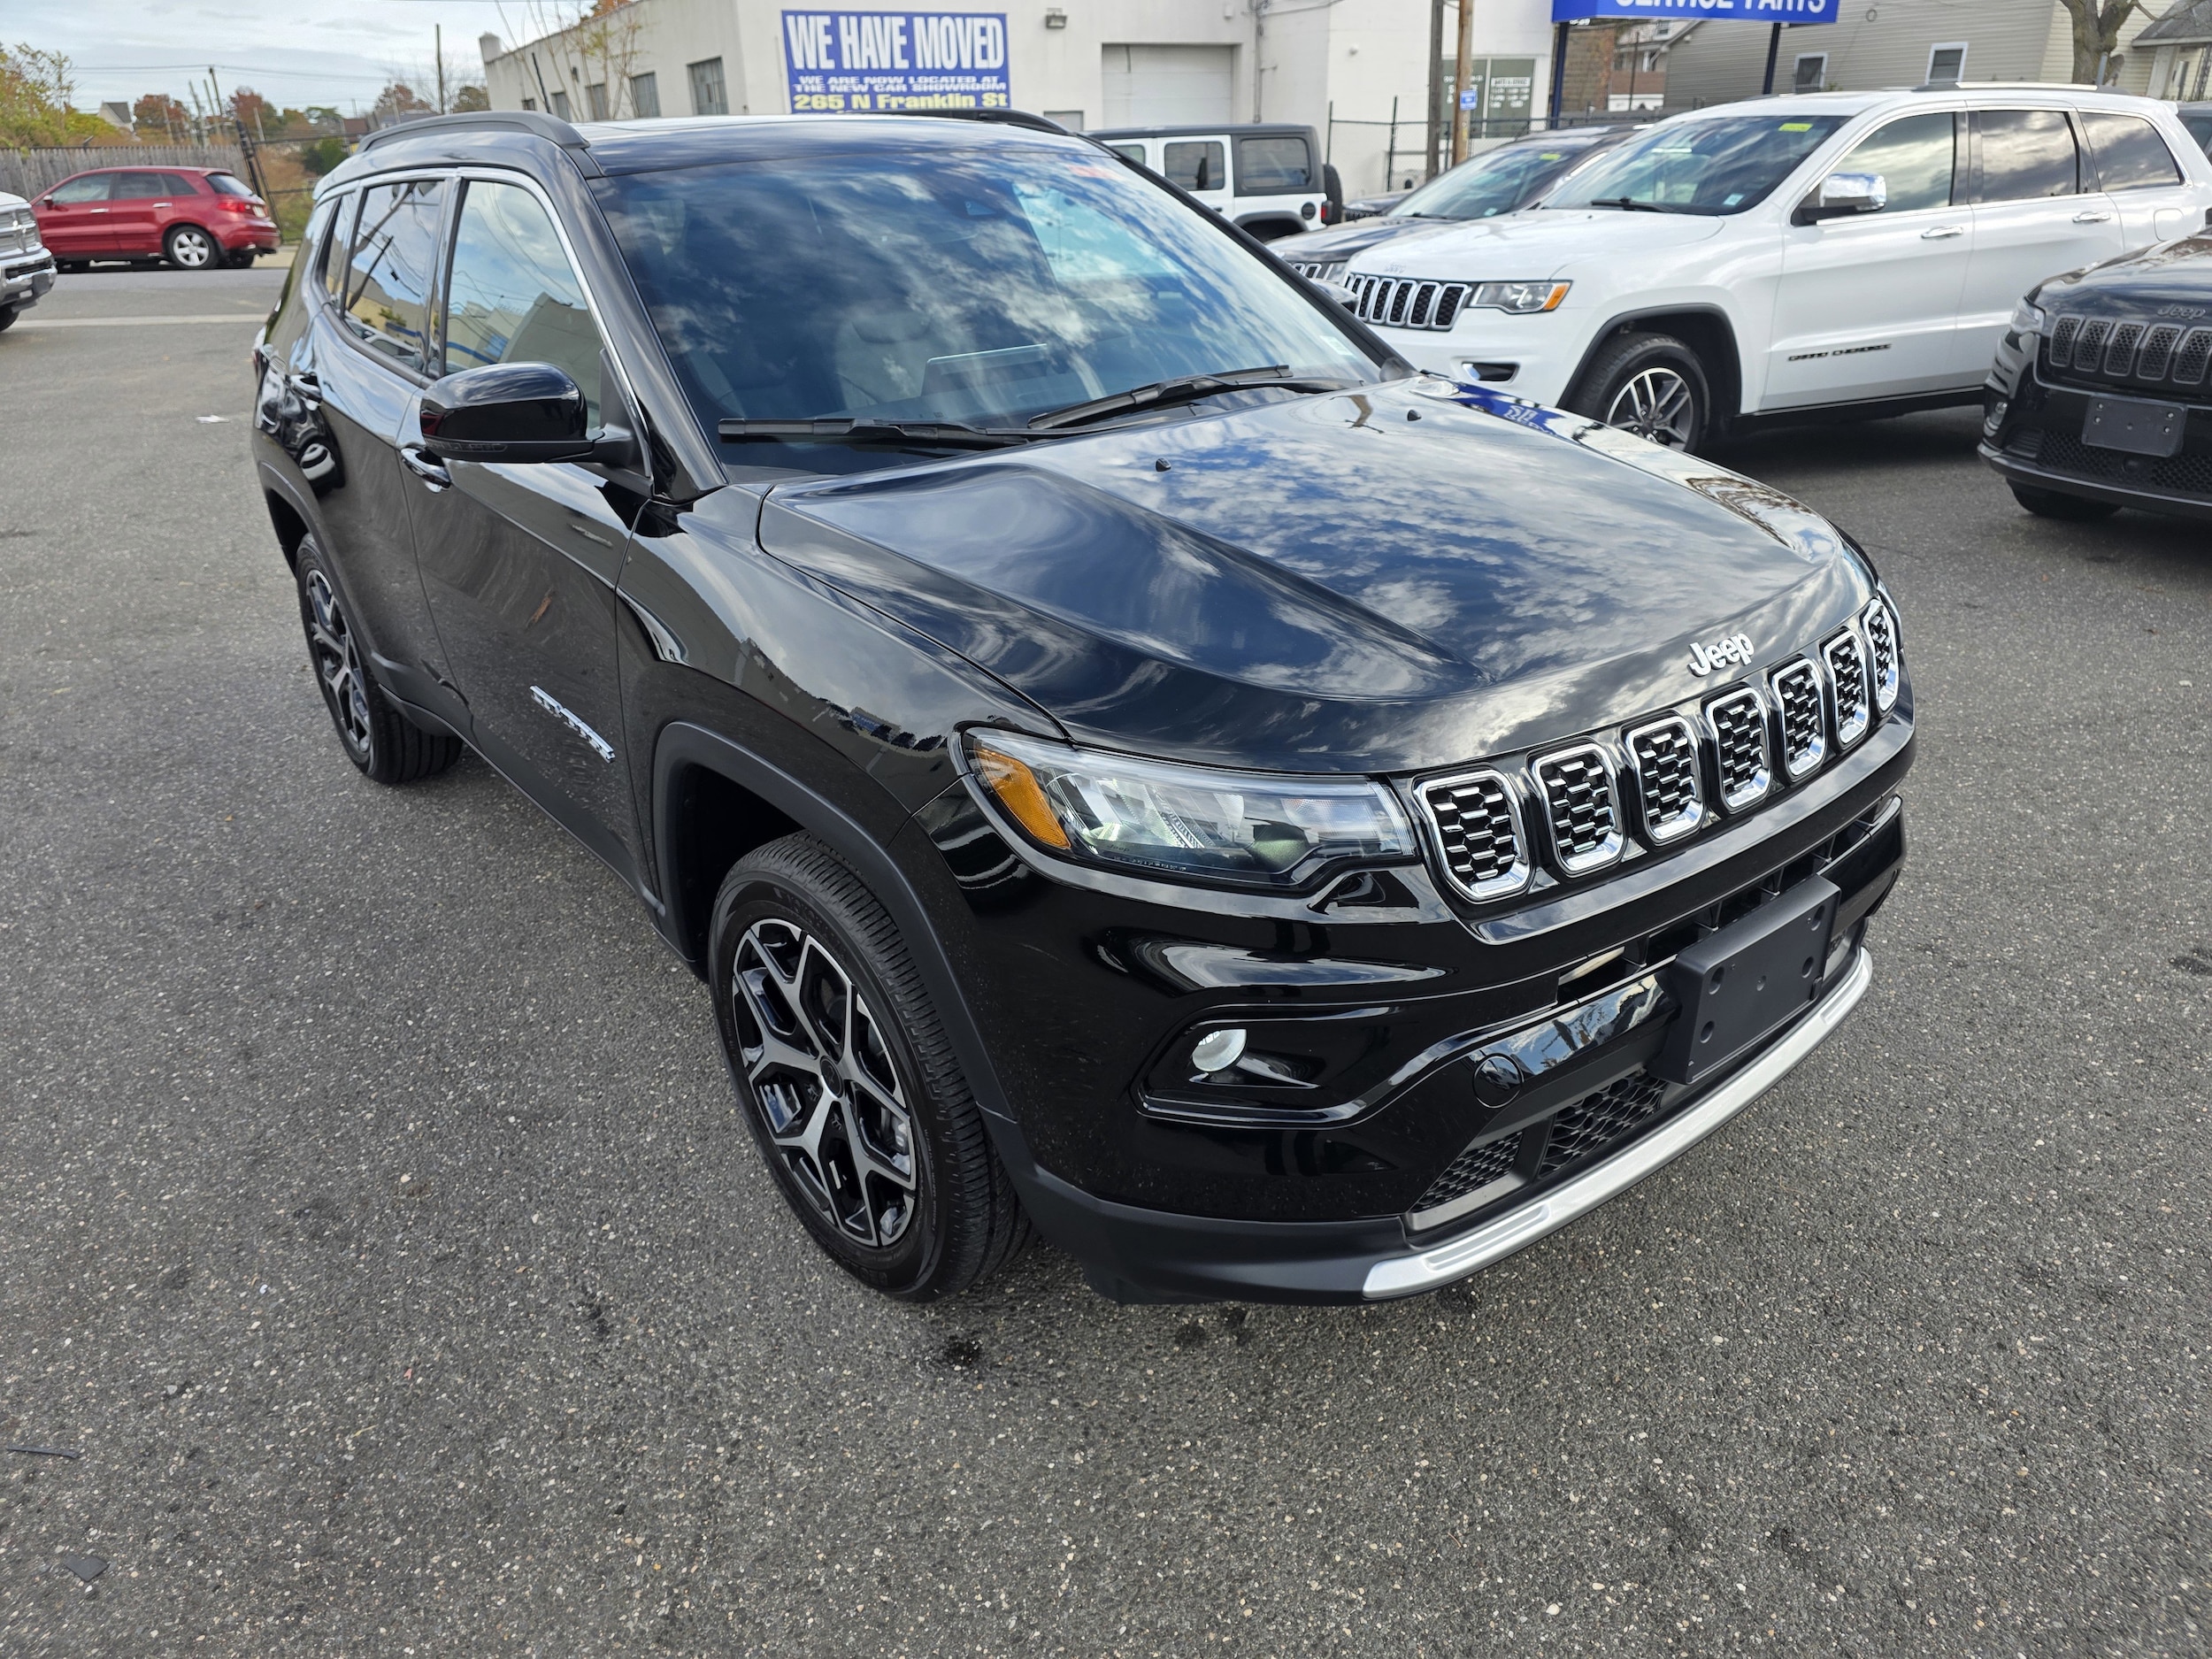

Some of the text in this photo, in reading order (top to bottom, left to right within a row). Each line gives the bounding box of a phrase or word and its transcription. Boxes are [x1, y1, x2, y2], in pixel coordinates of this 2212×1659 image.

[786, 14, 1005, 71] WE HAVE MOVED
[793, 83, 826, 93] THE
[829, 83, 869, 93] NEW
[798, 75, 824, 84] WE
[908, 75, 977, 84] LOCATED
[793, 92, 1008, 111] 265 N Franklin St
[2157, 303, 2206, 320] Jeep
[1687, 633, 1755, 677] Jeep
